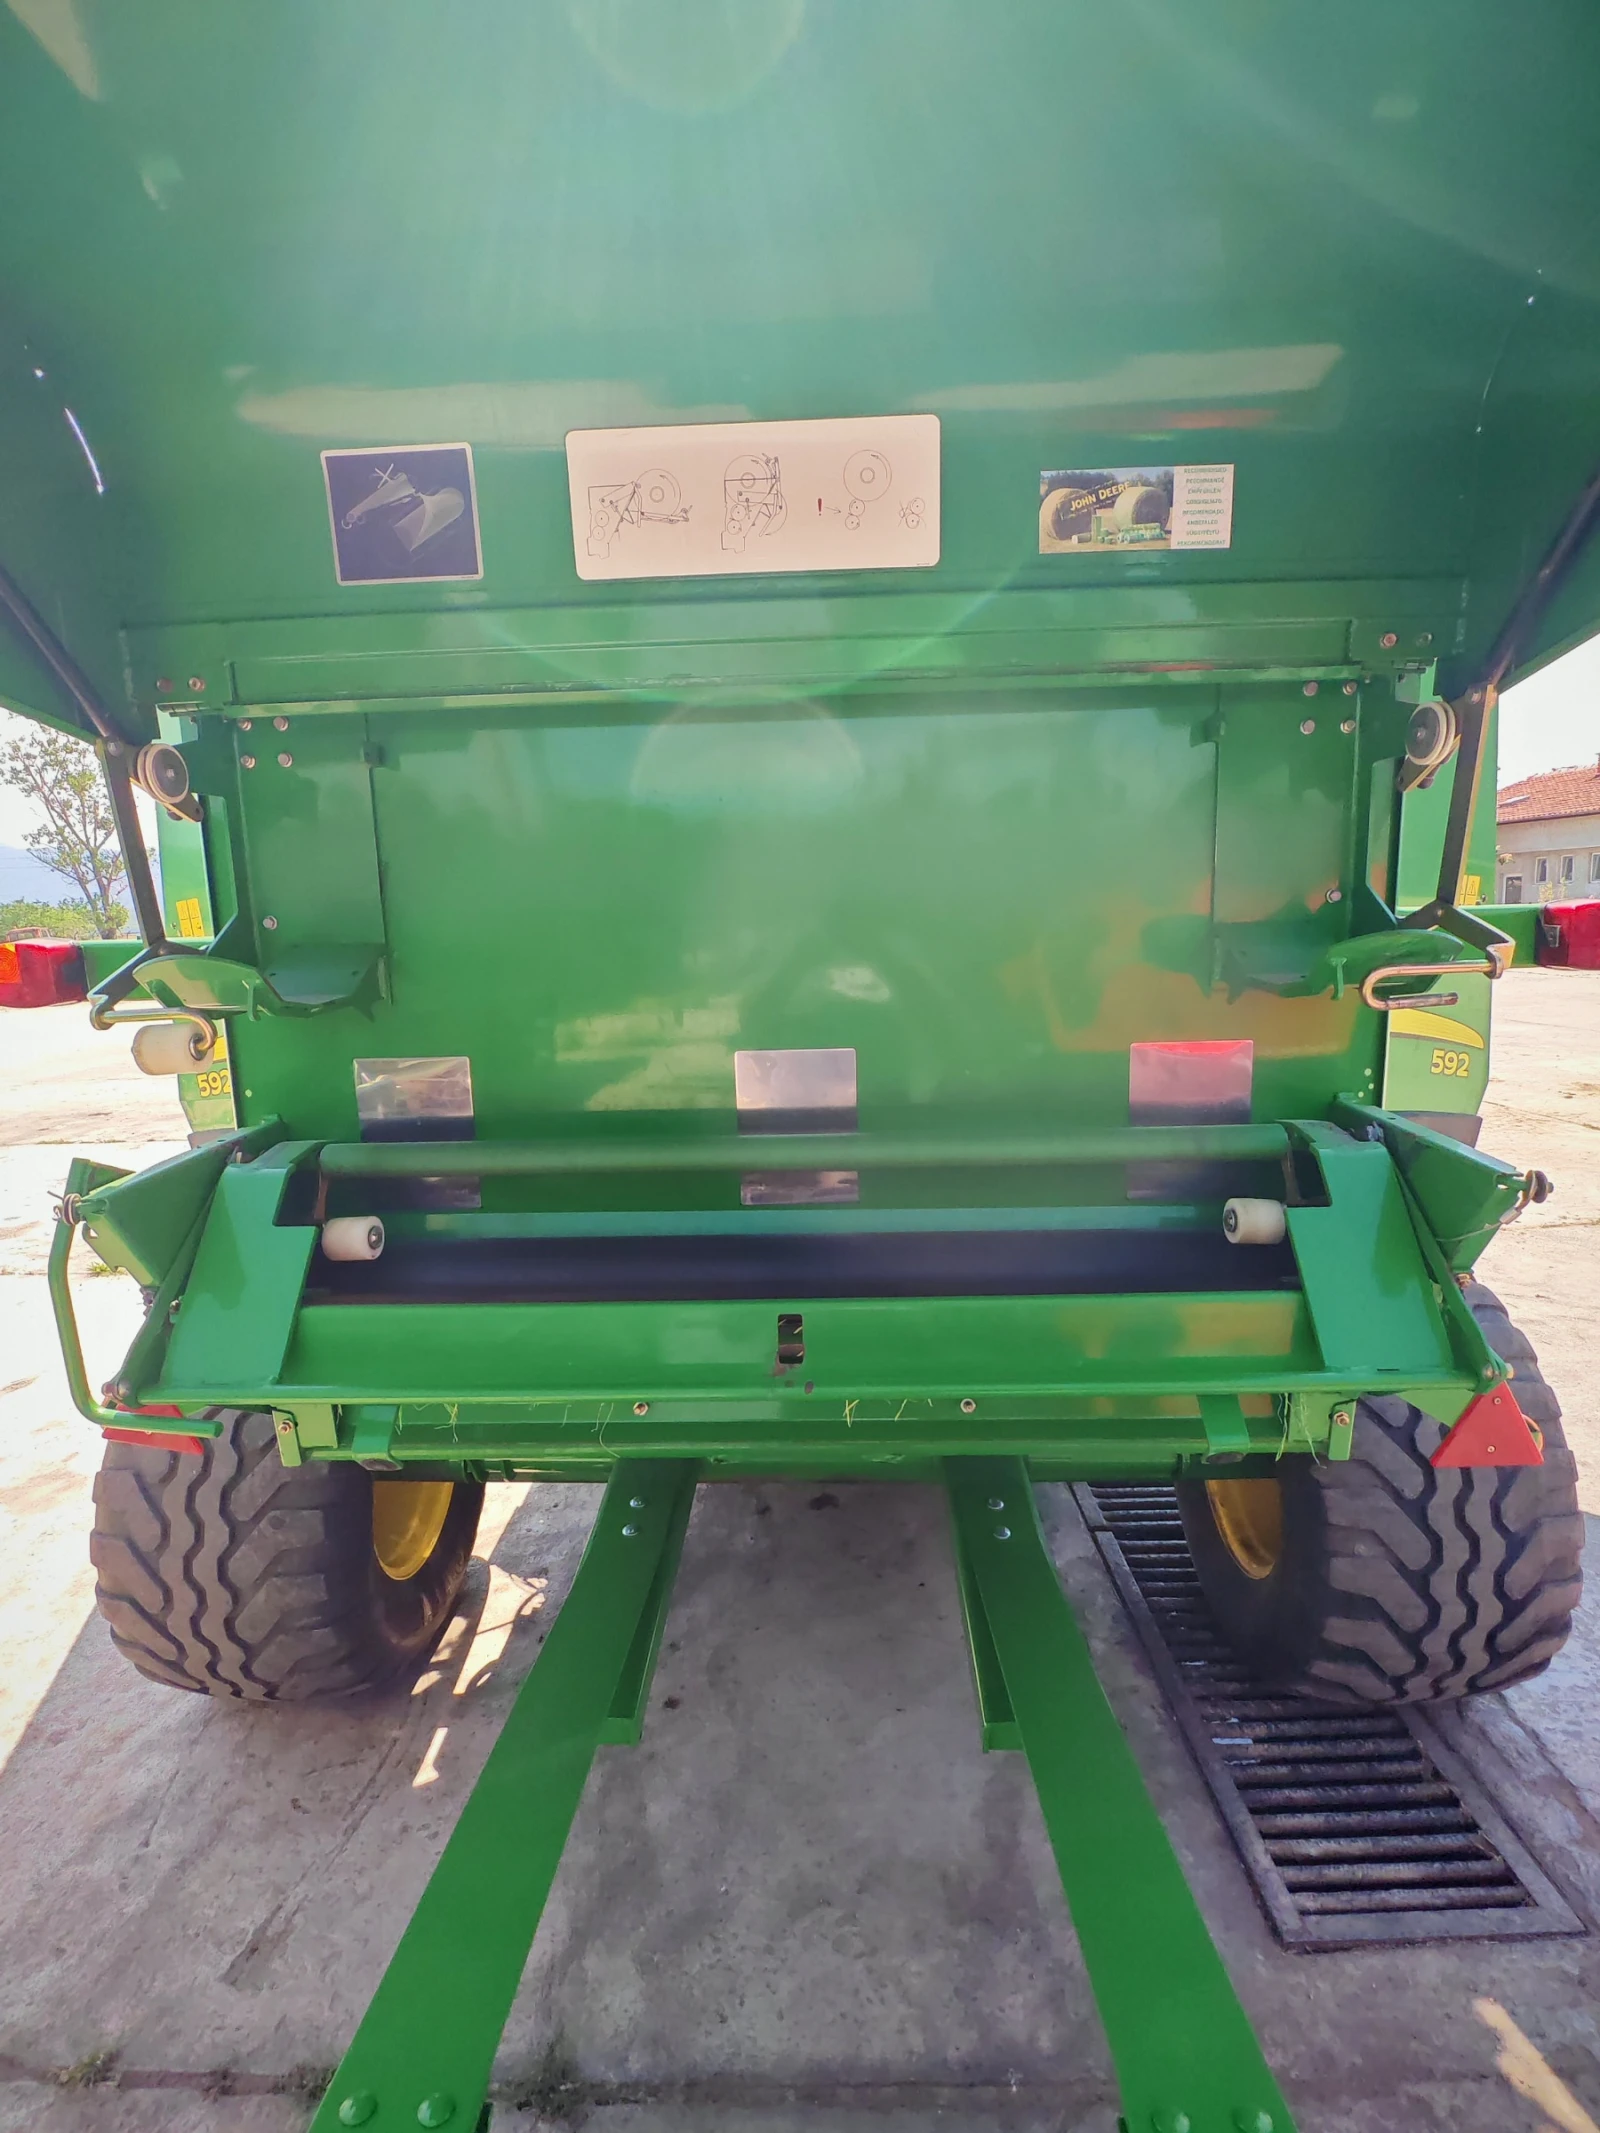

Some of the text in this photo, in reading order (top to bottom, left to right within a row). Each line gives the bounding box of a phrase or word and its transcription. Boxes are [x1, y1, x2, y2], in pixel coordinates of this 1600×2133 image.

[1070, 494, 1097, 511] JOHN
[1430, 1048, 1470, 1078] 592
[196, 1068, 231, 1098] 592
